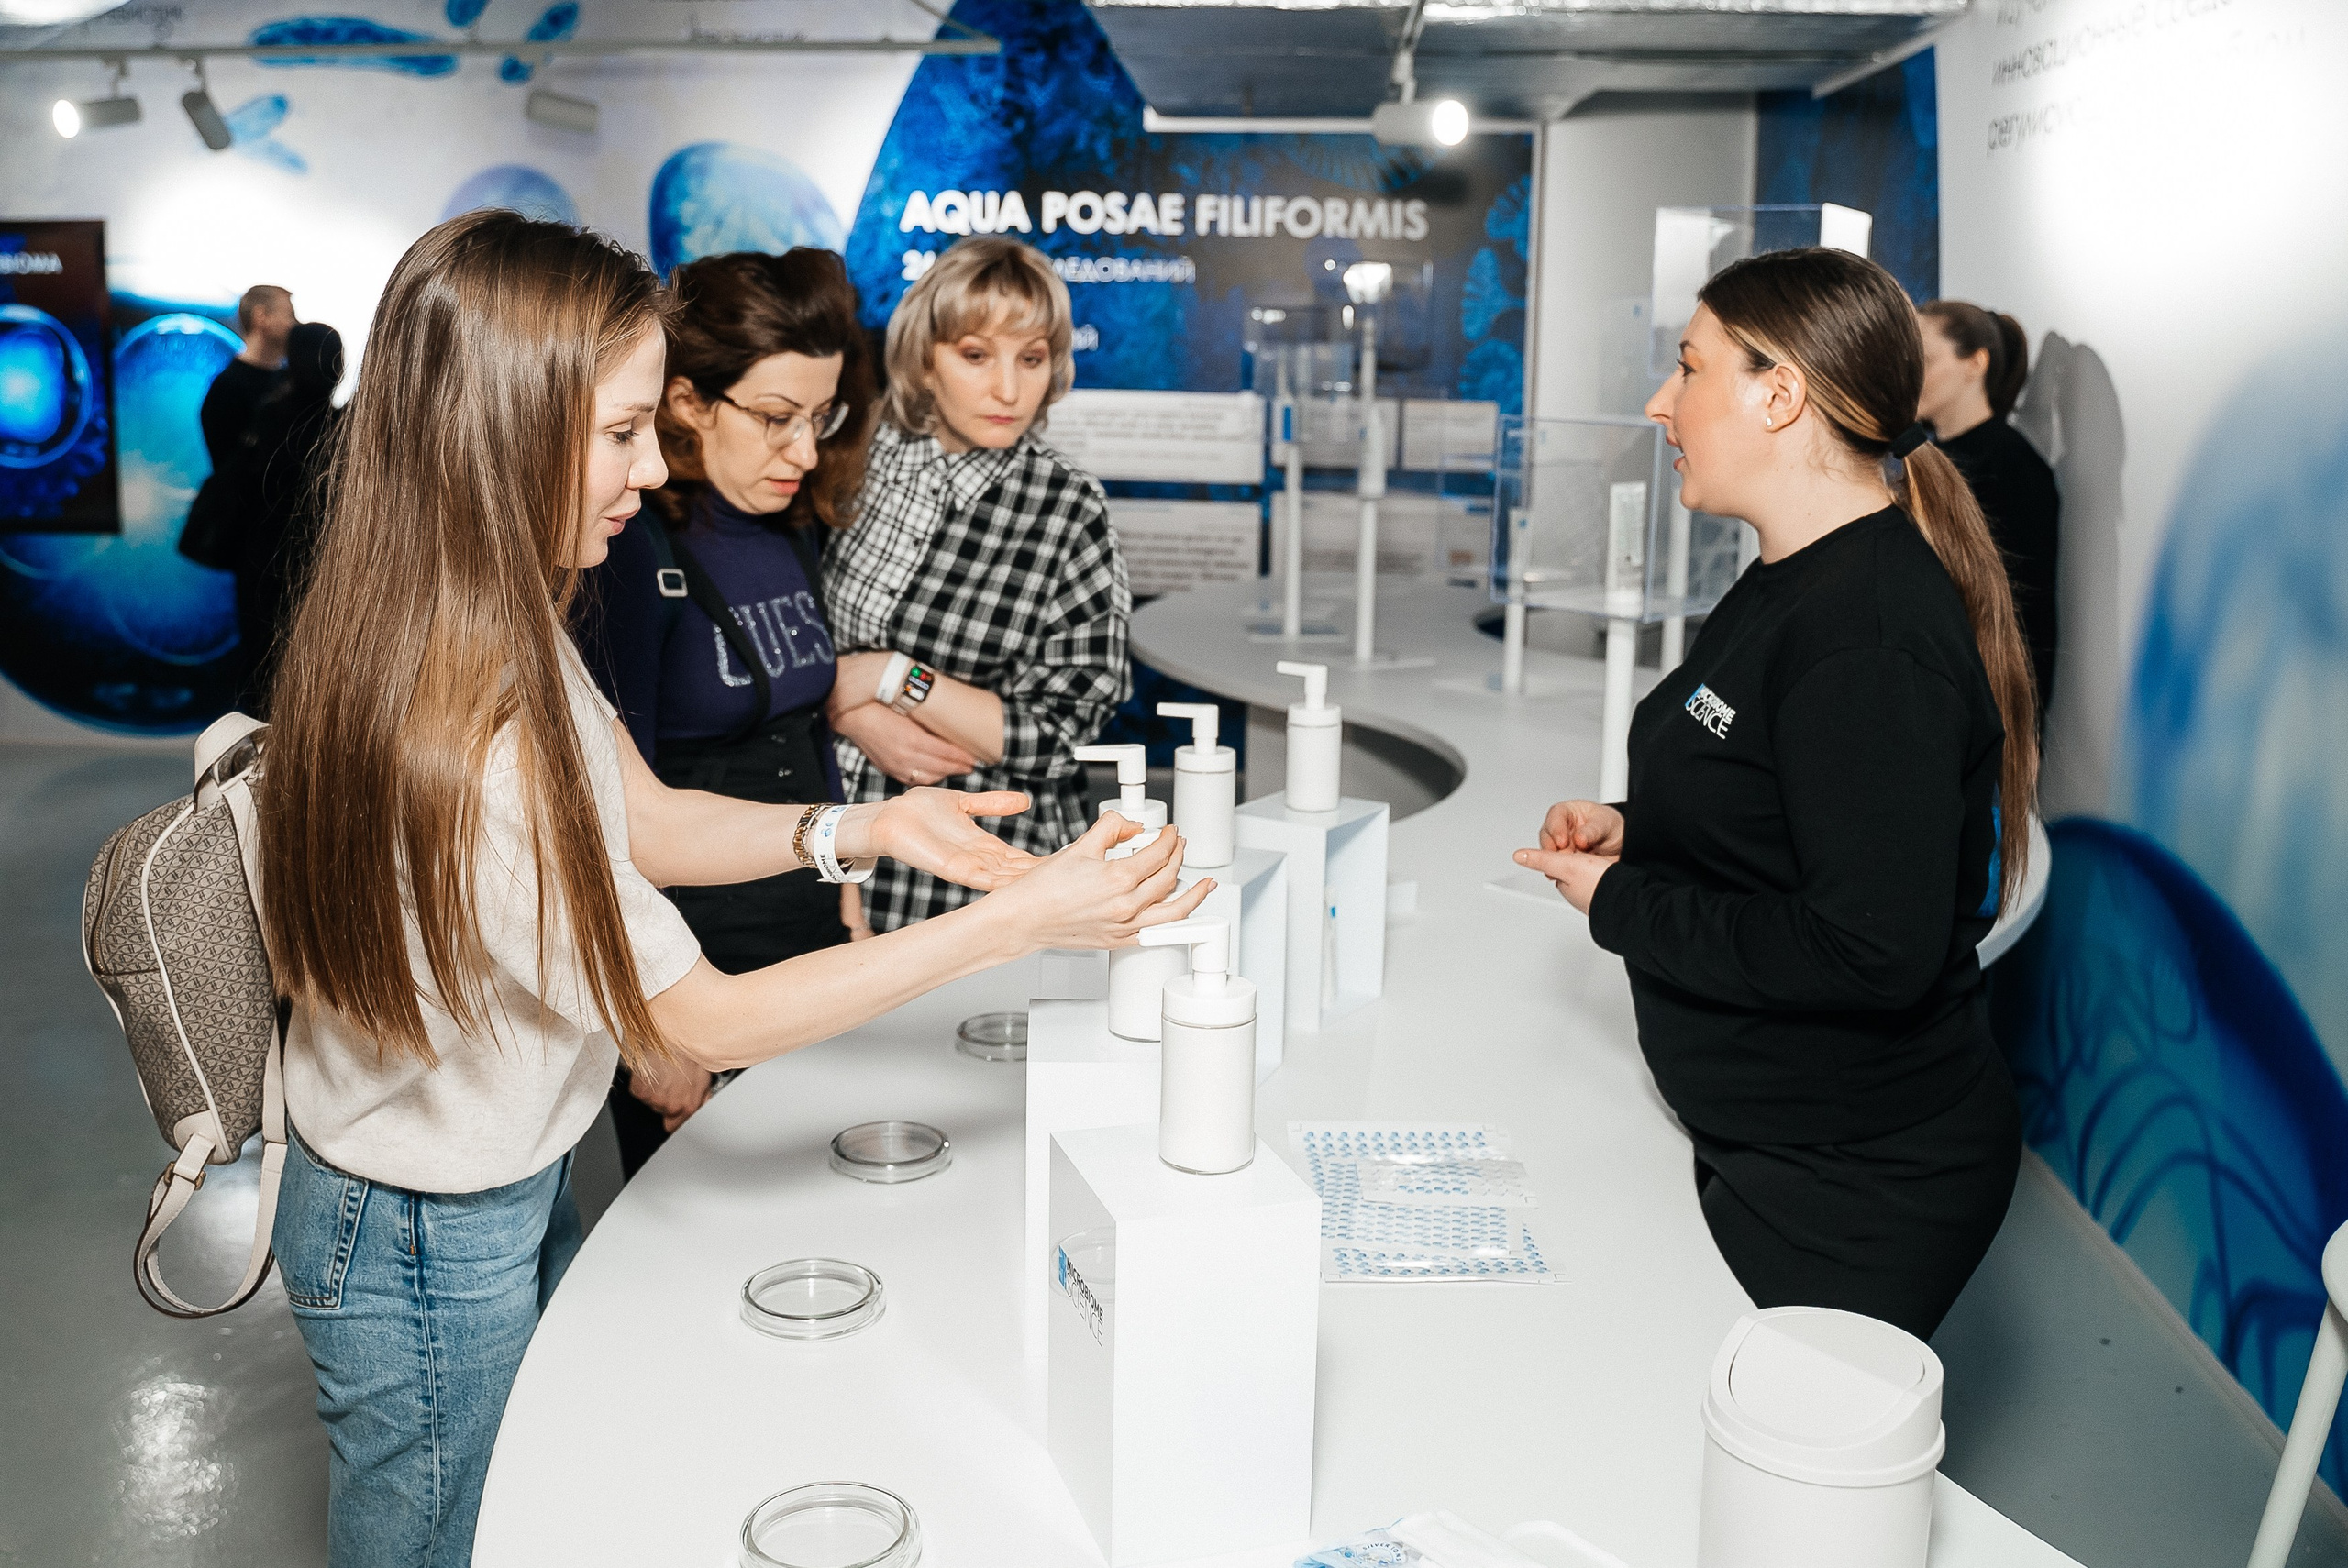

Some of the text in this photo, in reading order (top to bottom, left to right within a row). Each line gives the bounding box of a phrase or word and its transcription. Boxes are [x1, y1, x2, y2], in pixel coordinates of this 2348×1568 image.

[899, 189, 1429, 242] AQUA POSAE FILIFORMIS
[714, 590, 836, 686] UES
[1066, 1272, 1103, 1349] SCIENCE
[1067, 1256, 1103, 1323] MICROBIOME
[1363, 1542, 1402, 1562] SILVER IONS
